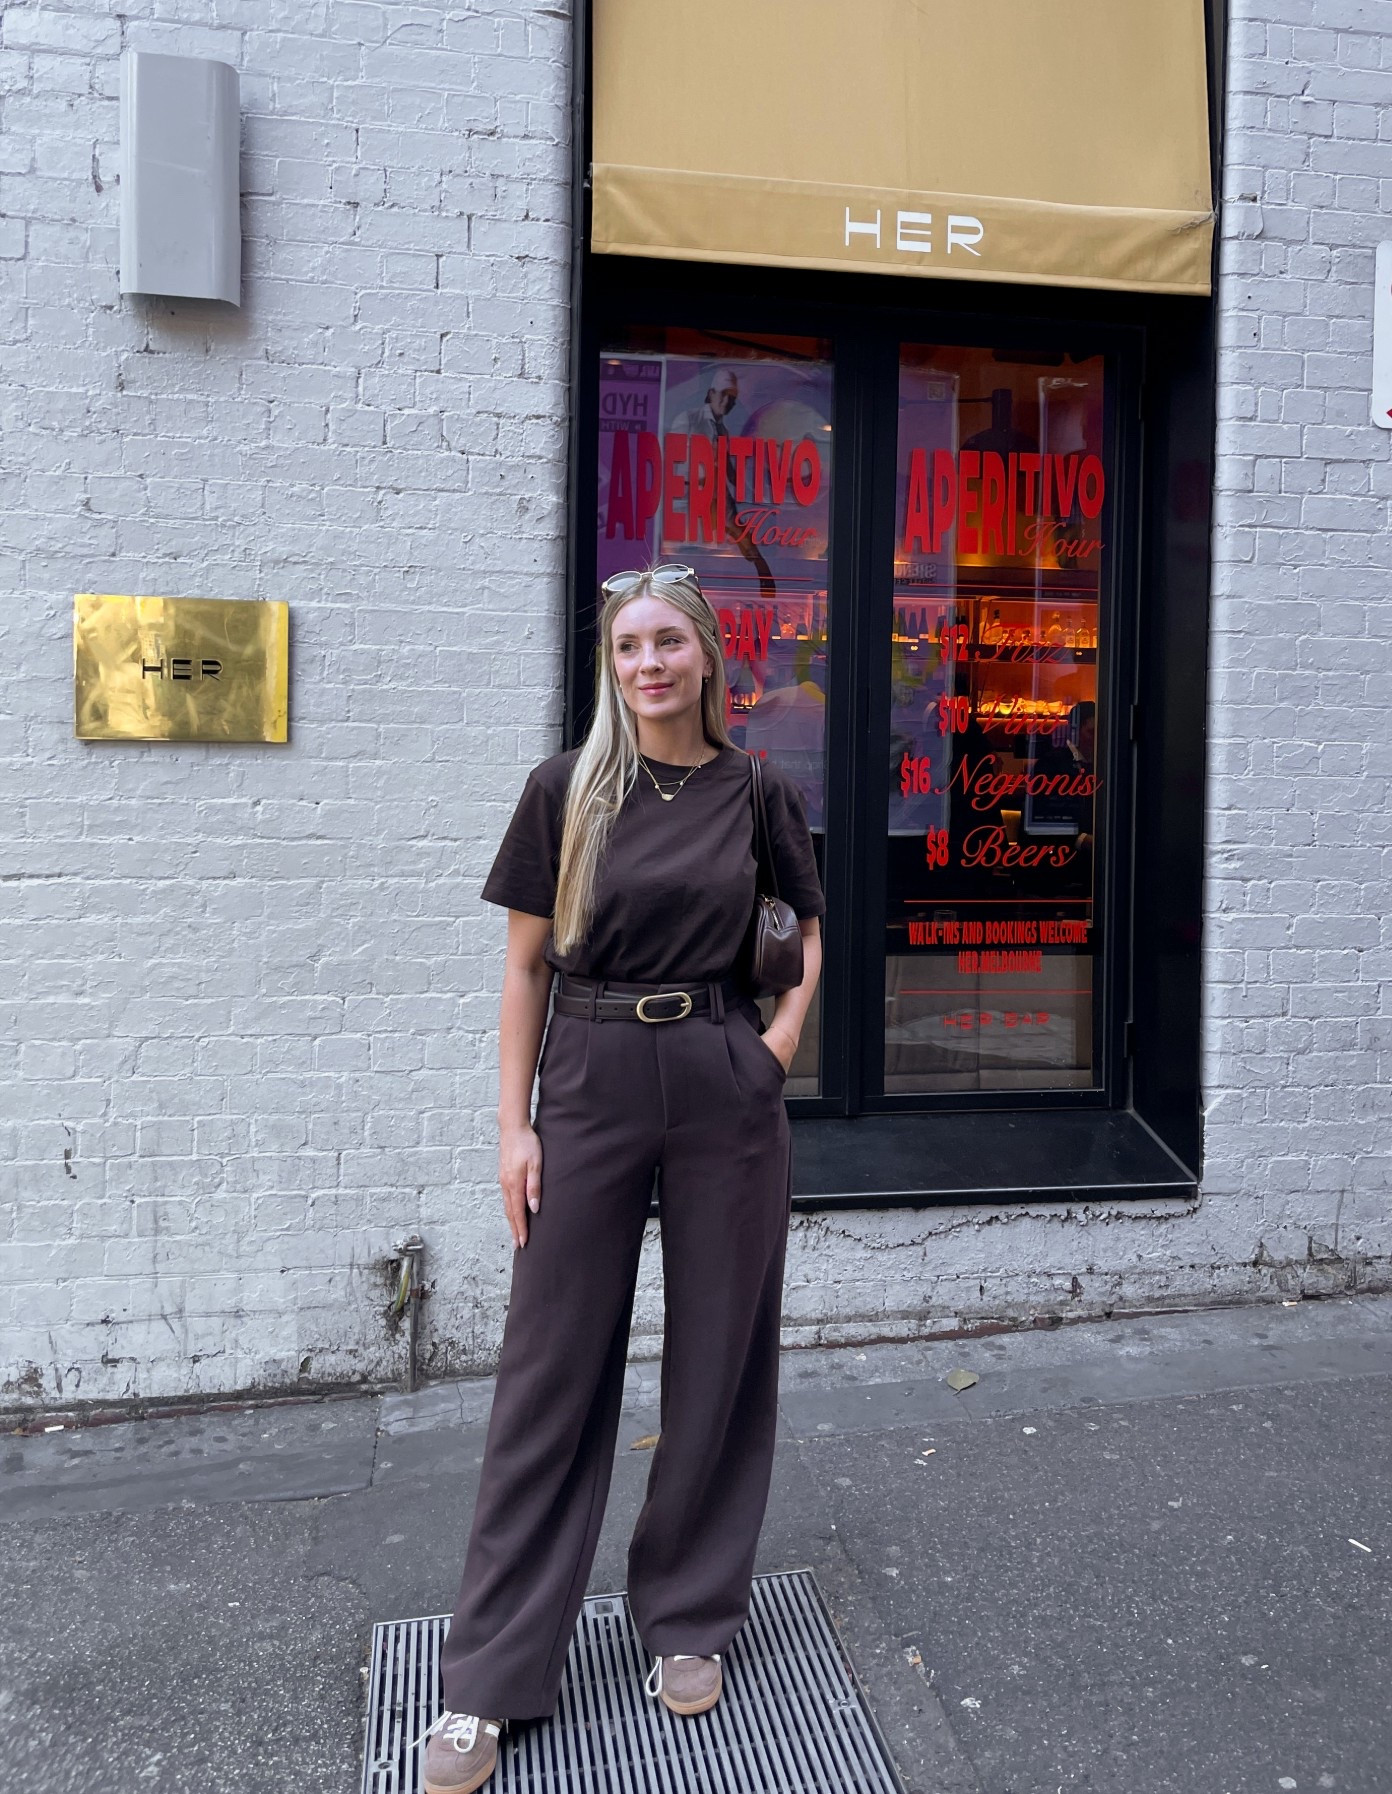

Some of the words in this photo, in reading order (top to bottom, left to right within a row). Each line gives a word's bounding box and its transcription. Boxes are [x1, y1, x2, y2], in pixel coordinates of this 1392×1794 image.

[845, 206, 984, 257] HER
[605, 430, 822, 544] APERITIVO
[904, 448, 1105, 556] APERITIVO
[727, 507, 818, 547] Hour
[1018, 521, 1106, 558] Hour
[716, 607, 774, 662] DAY
[940, 619, 969, 665] $12
[141, 658, 223, 681] HER
[938, 691, 969, 737] $10
[981, 693, 1066, 735] Vino
[901, 752, 932, 799] $16
[934, 753, 1104, 811] Negronis
[926, 824, 949, 871] $8
[960, 825, 1078, 868] Beers
[908, 921, 960, 945] WALK-INS
[962, 920, 983, 945] AND
[985, 920, 1037, 945] BOOKINGS
[1039, 920, 1088, 944] WELCOME
